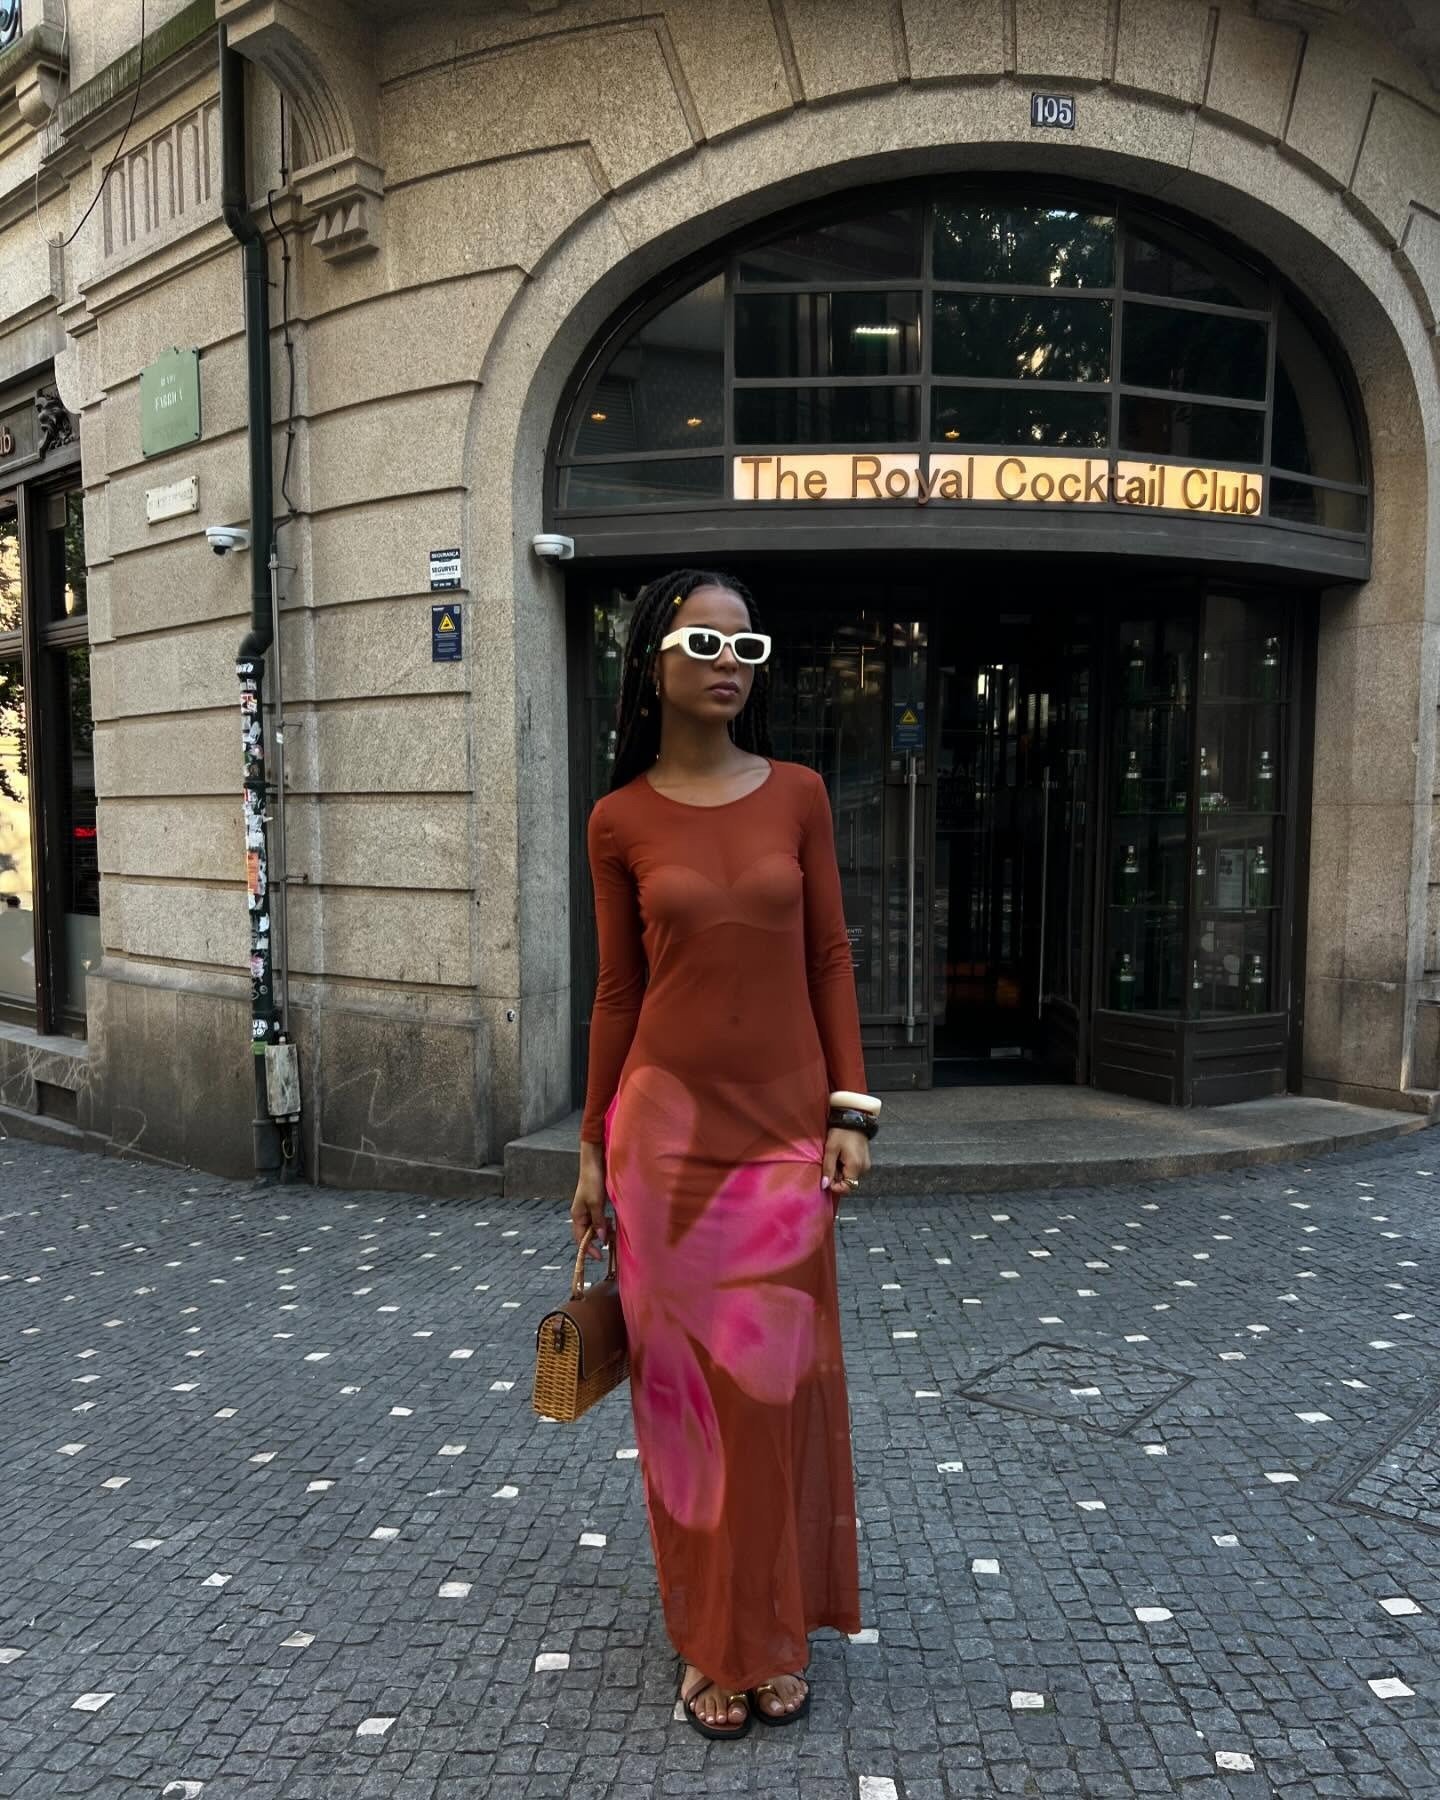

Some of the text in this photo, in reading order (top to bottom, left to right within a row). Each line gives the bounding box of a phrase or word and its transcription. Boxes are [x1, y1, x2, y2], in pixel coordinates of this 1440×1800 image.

[1035, 96, 1072, 124] 105
[741, 456, 1262, 517] The Royal Cocktail Club
